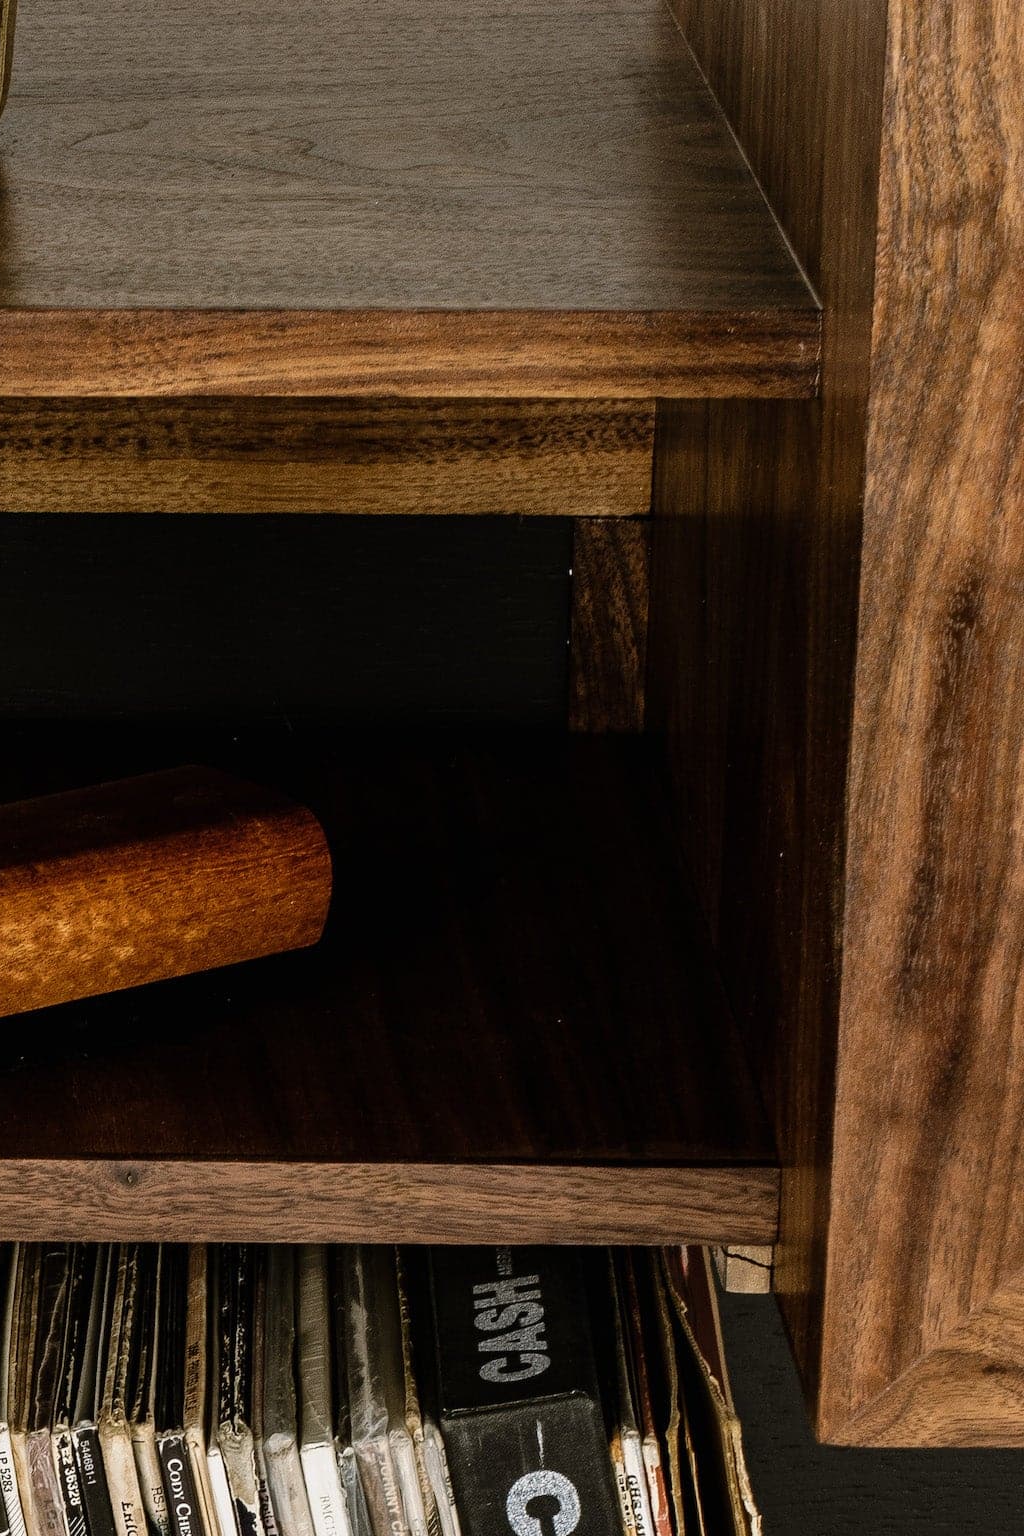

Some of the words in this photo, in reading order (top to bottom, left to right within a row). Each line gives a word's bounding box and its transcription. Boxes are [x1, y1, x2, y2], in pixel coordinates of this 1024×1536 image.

[473, 1274, 550, 1382] CASH
[78, 1440, 96, 1485] 544681-1
[378, 1459, 400, 1515] JOHNNY
